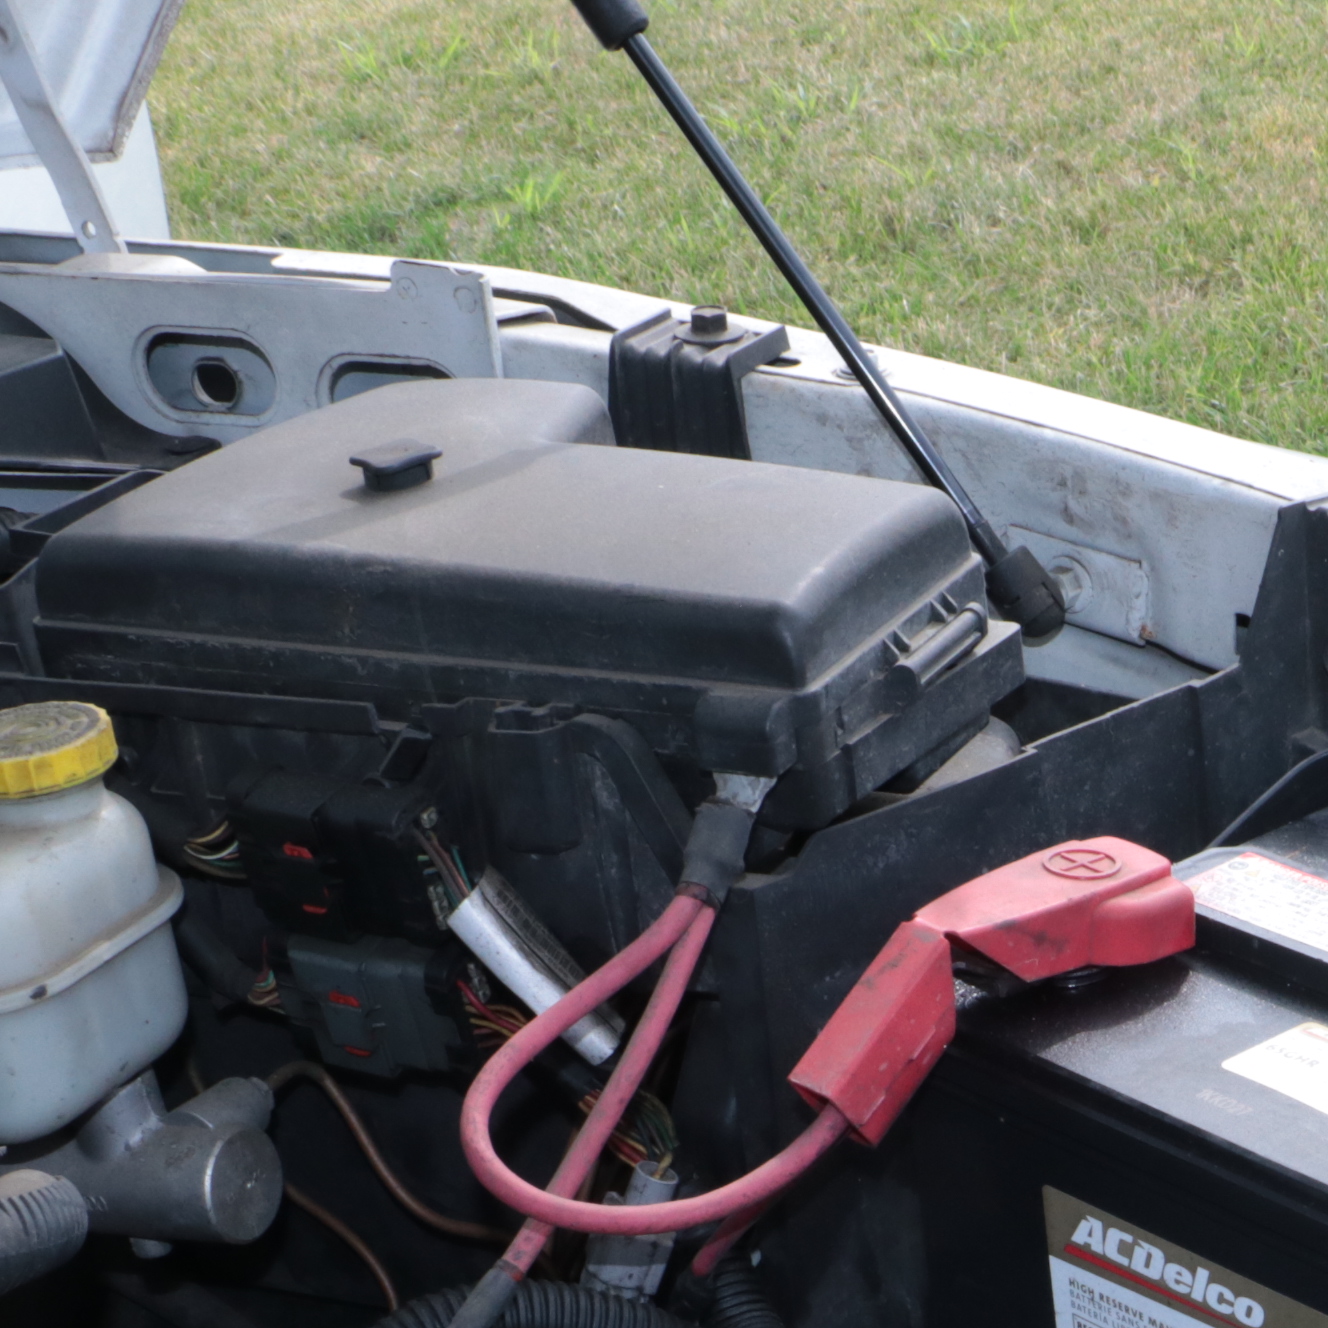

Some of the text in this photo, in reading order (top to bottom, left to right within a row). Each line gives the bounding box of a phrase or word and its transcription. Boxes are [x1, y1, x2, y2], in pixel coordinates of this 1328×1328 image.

[1070, 1214, 1265, 1328] ACDelco
[1068, 1276, 1094, 1298] HIGH
[1098, 1291, 1144, 1322] RESERVE
[1069, 1288, 1111, 1317] BATTERIE
